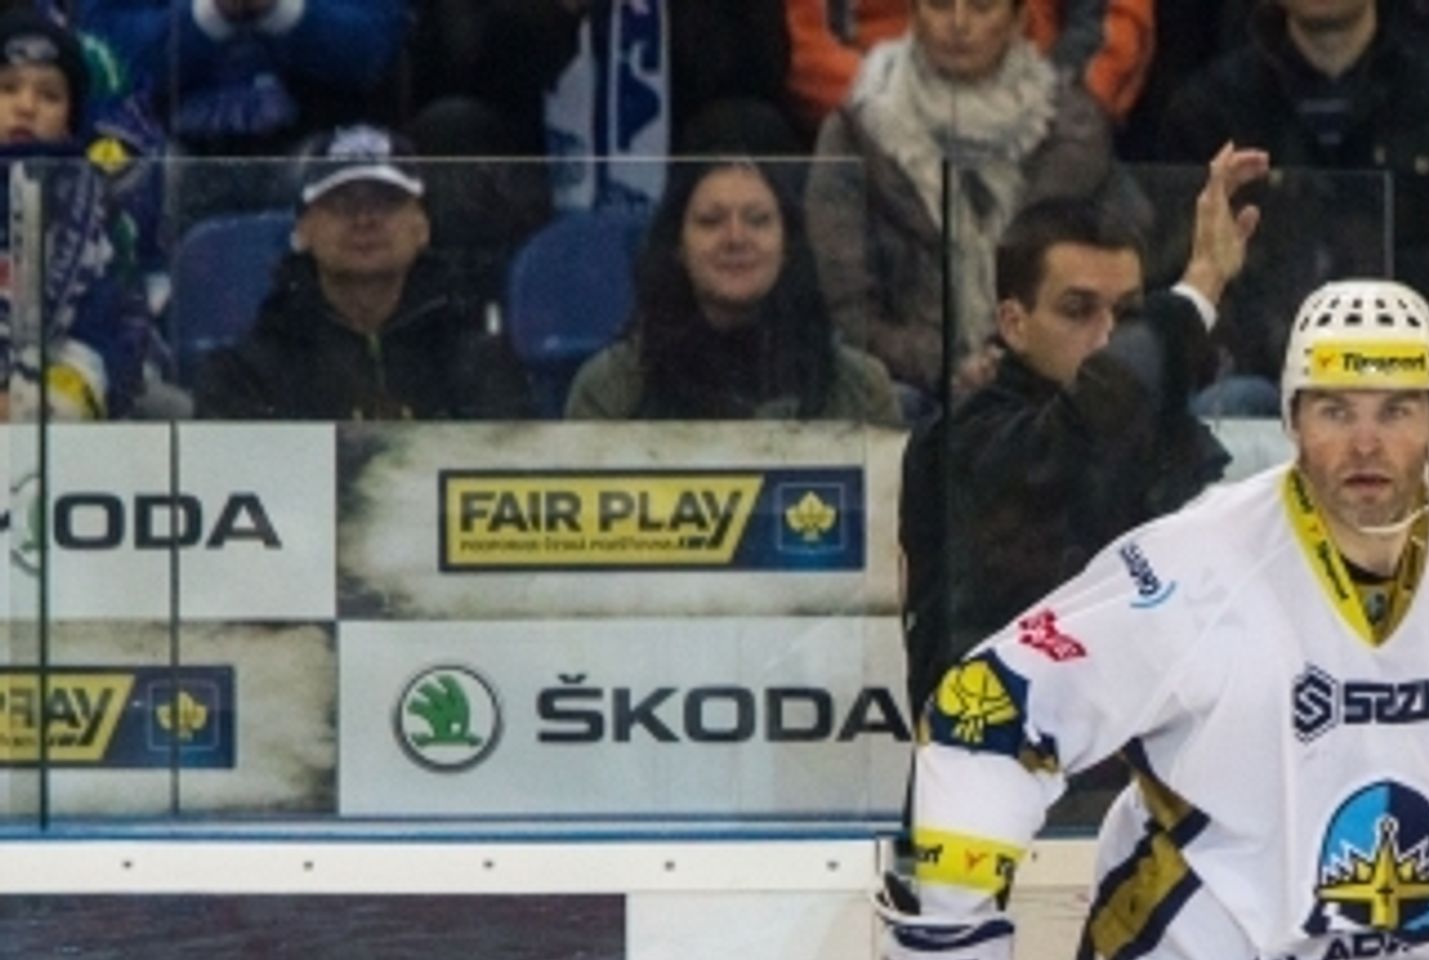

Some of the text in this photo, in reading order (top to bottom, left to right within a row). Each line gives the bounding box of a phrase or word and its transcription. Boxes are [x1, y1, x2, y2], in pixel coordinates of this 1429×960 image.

[459, 490, 743, 549] FAIR PLAY
[536, 673, 911, 743] ŠKODA
